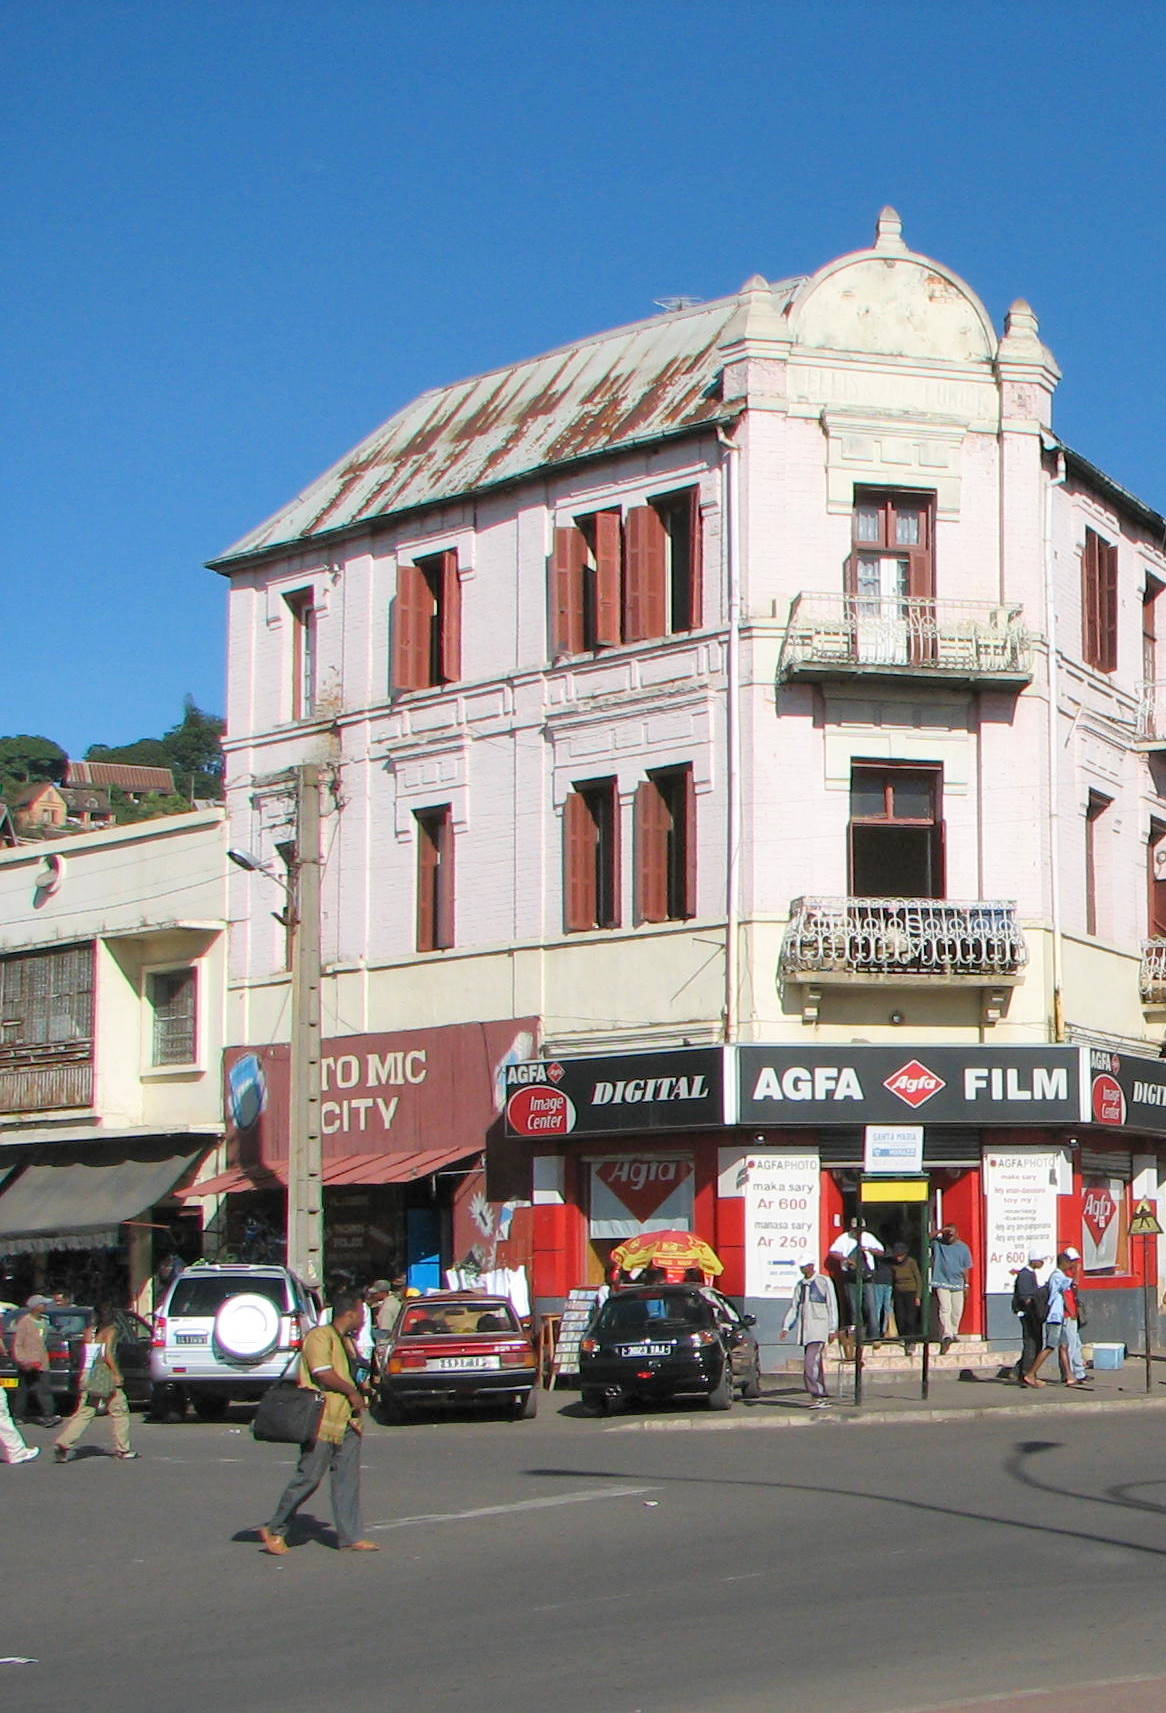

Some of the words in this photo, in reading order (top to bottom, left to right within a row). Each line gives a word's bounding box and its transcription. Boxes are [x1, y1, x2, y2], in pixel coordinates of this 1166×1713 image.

[1091, 1050, 1112, 1072] AGFA
[507, 1064, 548, 1085] AGFA
[591, 1075, 710, 1105] DIGITAL
[753, 1067, 864, 1100] AGFA
[892, 1074, 936, 1092] Agfa
[964, 1068, 1068, 1100] FILM
[530, 1096, 564, 1114] Image
[321, 1097, 399, 1134] CITY
[527, 1113, 563, 1130] Center
[757, 1160, 817, 1170] AGFAPHOTO
[788, 1183, 815, 1194] sary
[757, 1199, 774, 1210] Ar
[779, 1198, 807, 1210] 600
[1083, 1194, 1111, 1223] Agfa
[791, 1221, 813, 1232] sary
[757, 1236, 774, 1248] Ar
[779, 1236, 807, 1248] 250
[990, 1252, 1003, 1263] Ar
[1006, 1252, 1025, 1263] 600
